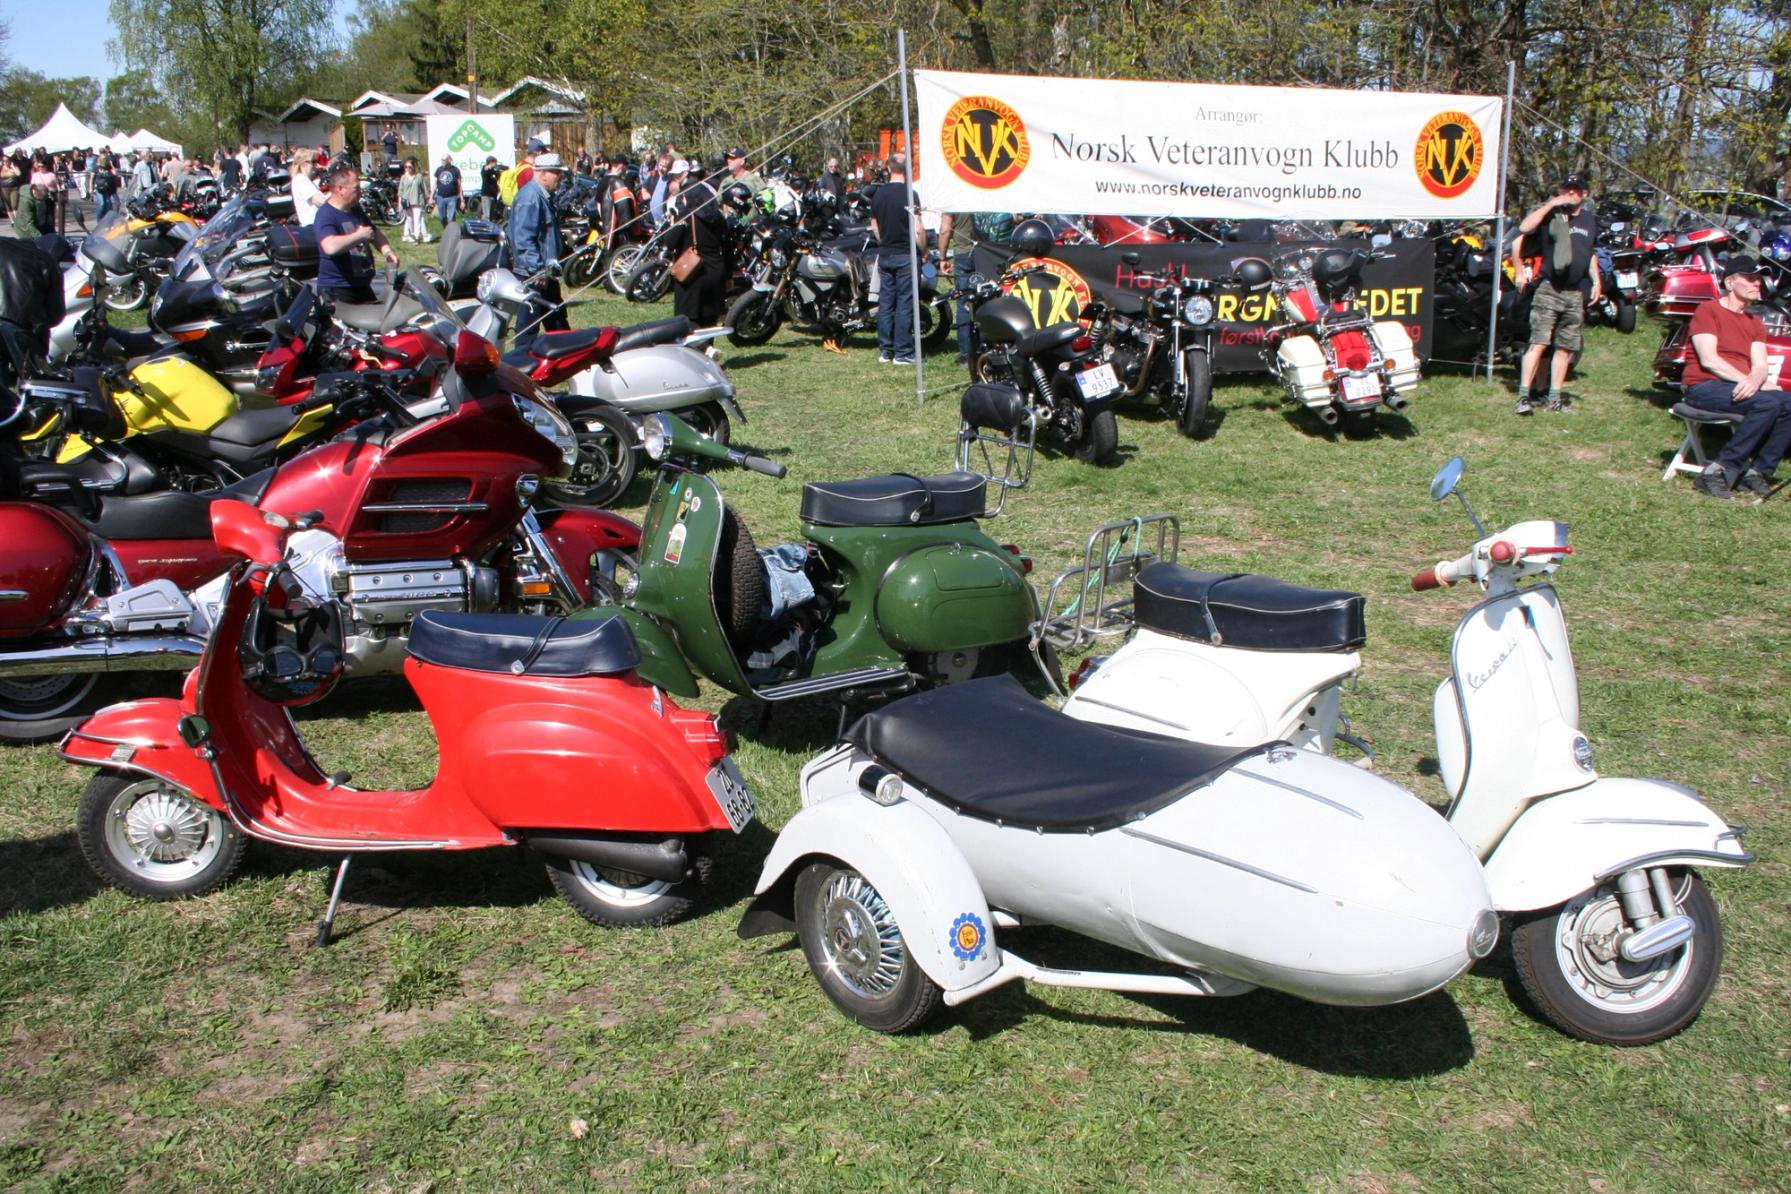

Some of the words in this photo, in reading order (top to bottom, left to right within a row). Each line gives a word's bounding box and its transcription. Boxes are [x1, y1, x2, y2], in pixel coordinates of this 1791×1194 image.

[1050, 132, 1137, 164] Norsk
[1146, 135, 1313, 175] Veteranvogn
[1323, 139, 1399, 169] Klubb
[1095, 180, 1362, 203] www.norskveteranvognklubb.no
